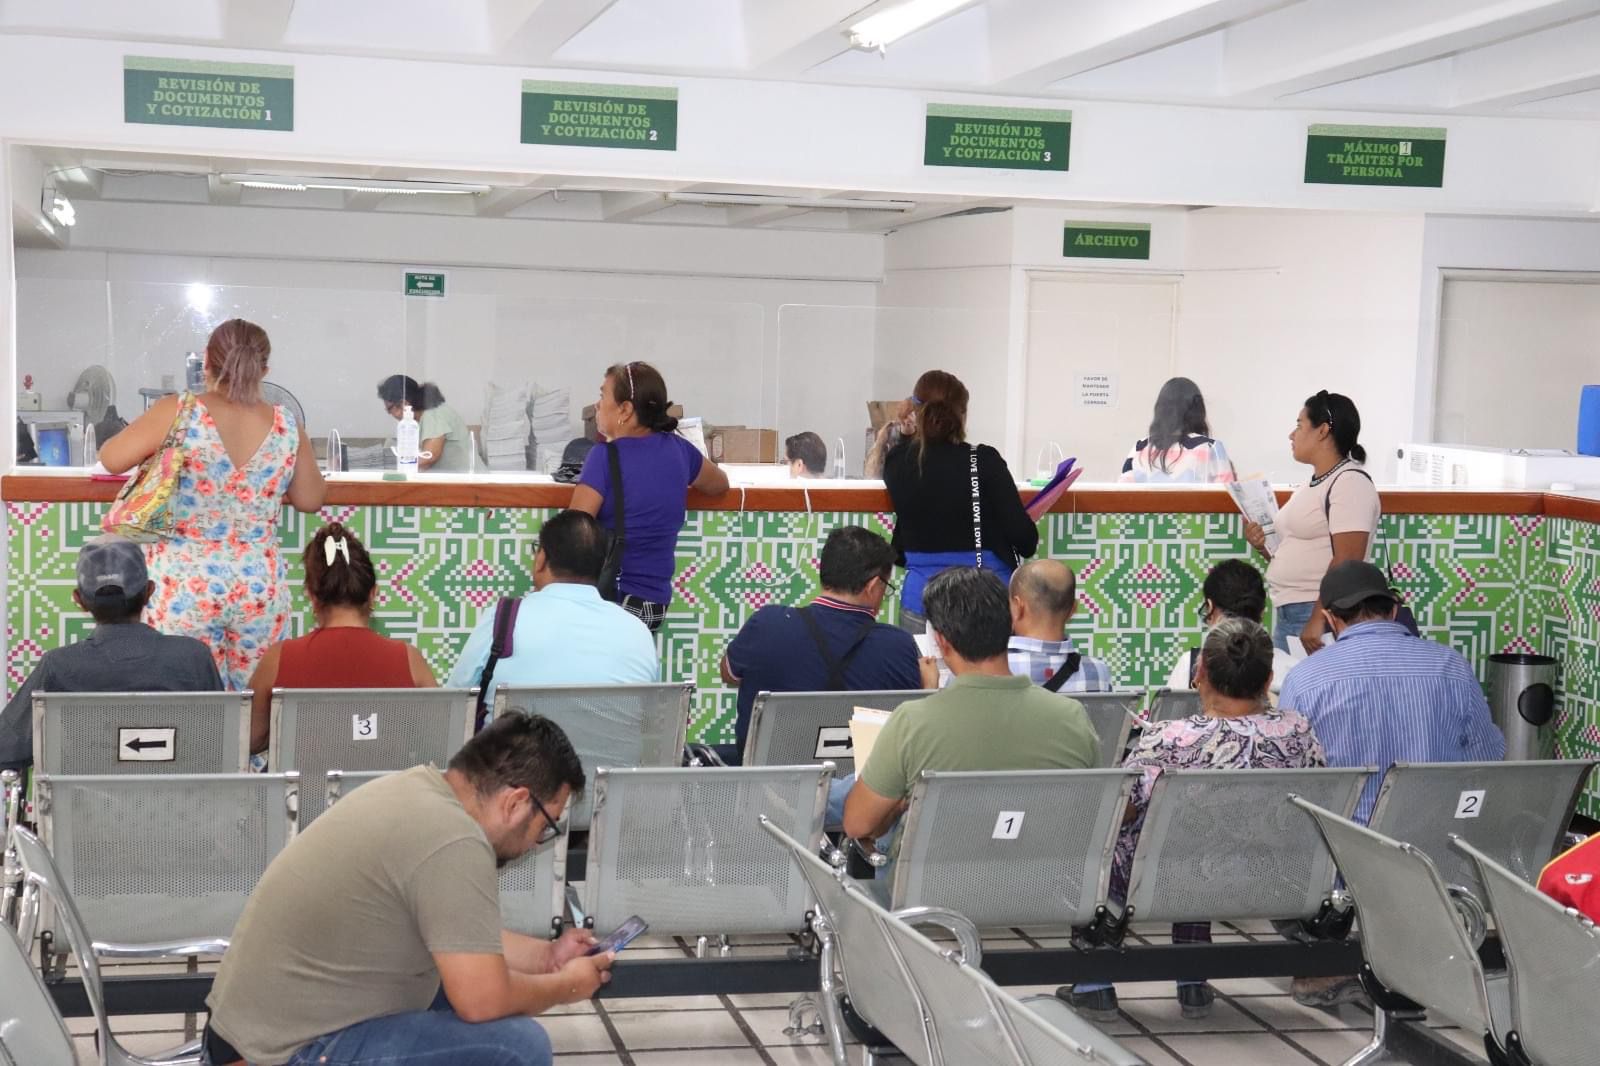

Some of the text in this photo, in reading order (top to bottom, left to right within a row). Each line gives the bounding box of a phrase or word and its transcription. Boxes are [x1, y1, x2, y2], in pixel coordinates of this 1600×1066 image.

[158, 77, 261, 94] REVISIÓN DE
[153, 90, 265, 107] DOCUMENTOS
[146, 103, 272, 121] Y COTIZACIÓN 1
[553, 100, 647, 115] REVISIÓN DE
[549, 113, 651, 128] DOCUMENTOS
[541, 125, 658, 141] Y COTIZACIÓN 2
[954, 122, 1042, 137] REVISIÓN DE
[950, 135, 1046, 150] DOCUMENTOS
[1343, 140, 1409, 155] MÁXIMO 1
[942, 147, 1052, 162] Y COTIZACIÓN 3
[1327, 152, 1423, 167] TRÁMITES POR
[1343, 166, 1403, 178] PERSONA
[970, 454, 978, 473] LOVE
[970, 476, 980, 498] LOVE
[972, 501, 981, 523] LOVE
[974, 527, 982, 548] LOVE
[359, 719, 371, 736] 3
[1462, 796, 1478, 813] 2
[1005, 817, 1014, 834] 1
